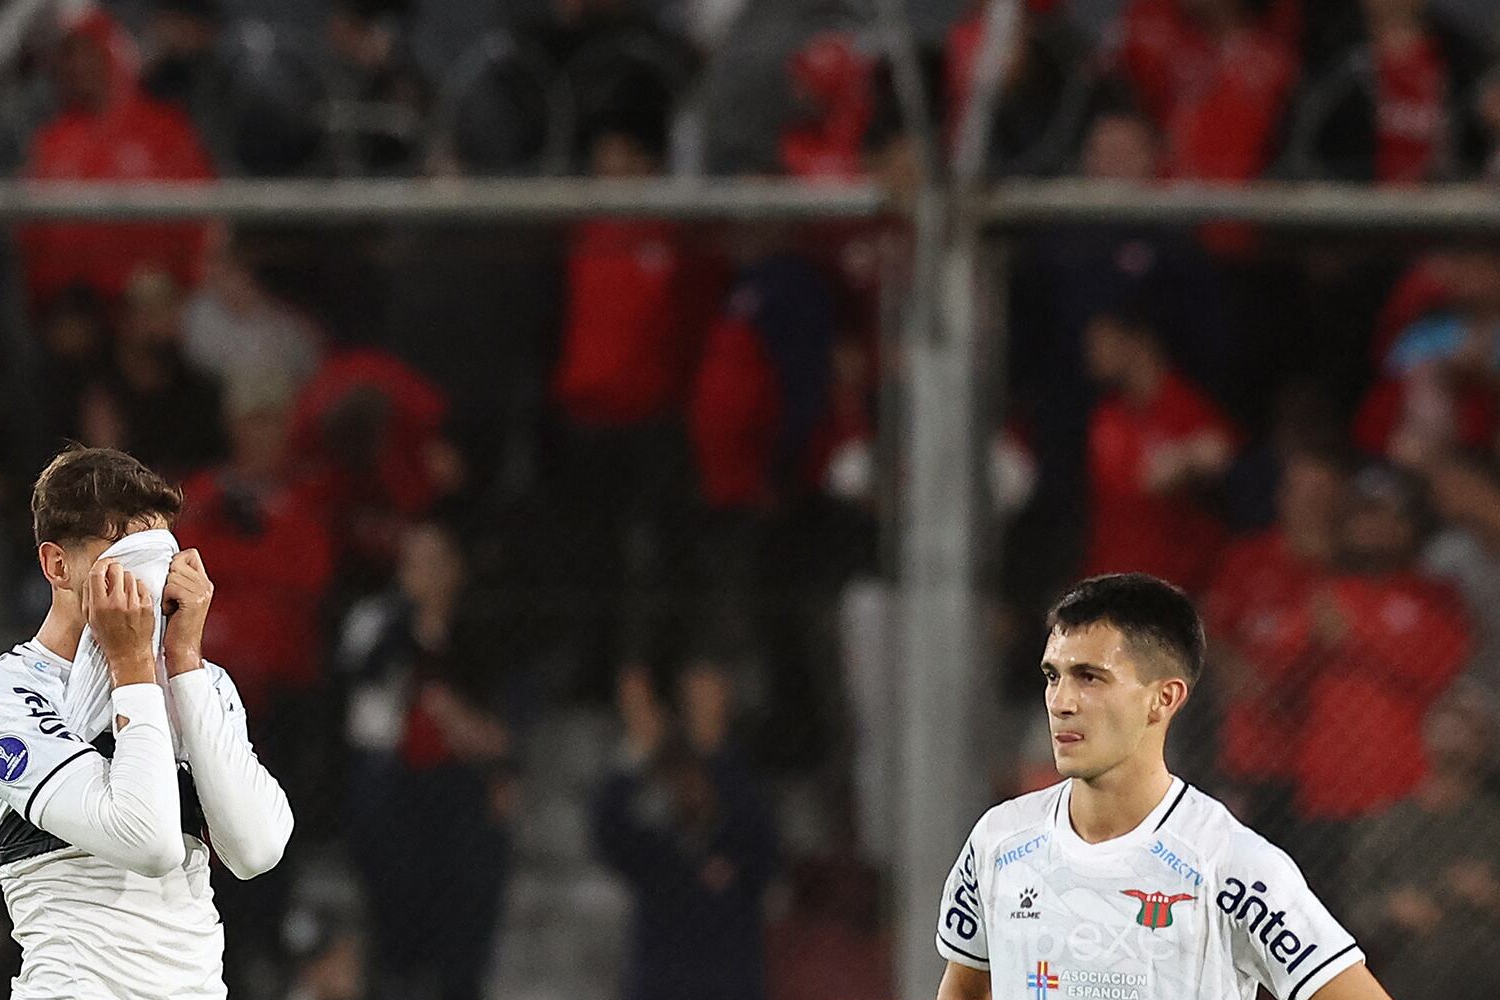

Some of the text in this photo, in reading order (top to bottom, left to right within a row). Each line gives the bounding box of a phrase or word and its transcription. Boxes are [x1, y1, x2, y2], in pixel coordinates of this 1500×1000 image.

[996, 834, 1051, 872] DIRECTV
[1150, 840, 1204, 887] DIRECTV
[1010, 911, 1041, 919] KELME
[1216, 877, 1318, 975] antel
[1061, 969, 1147, 986] ASOCIACION
